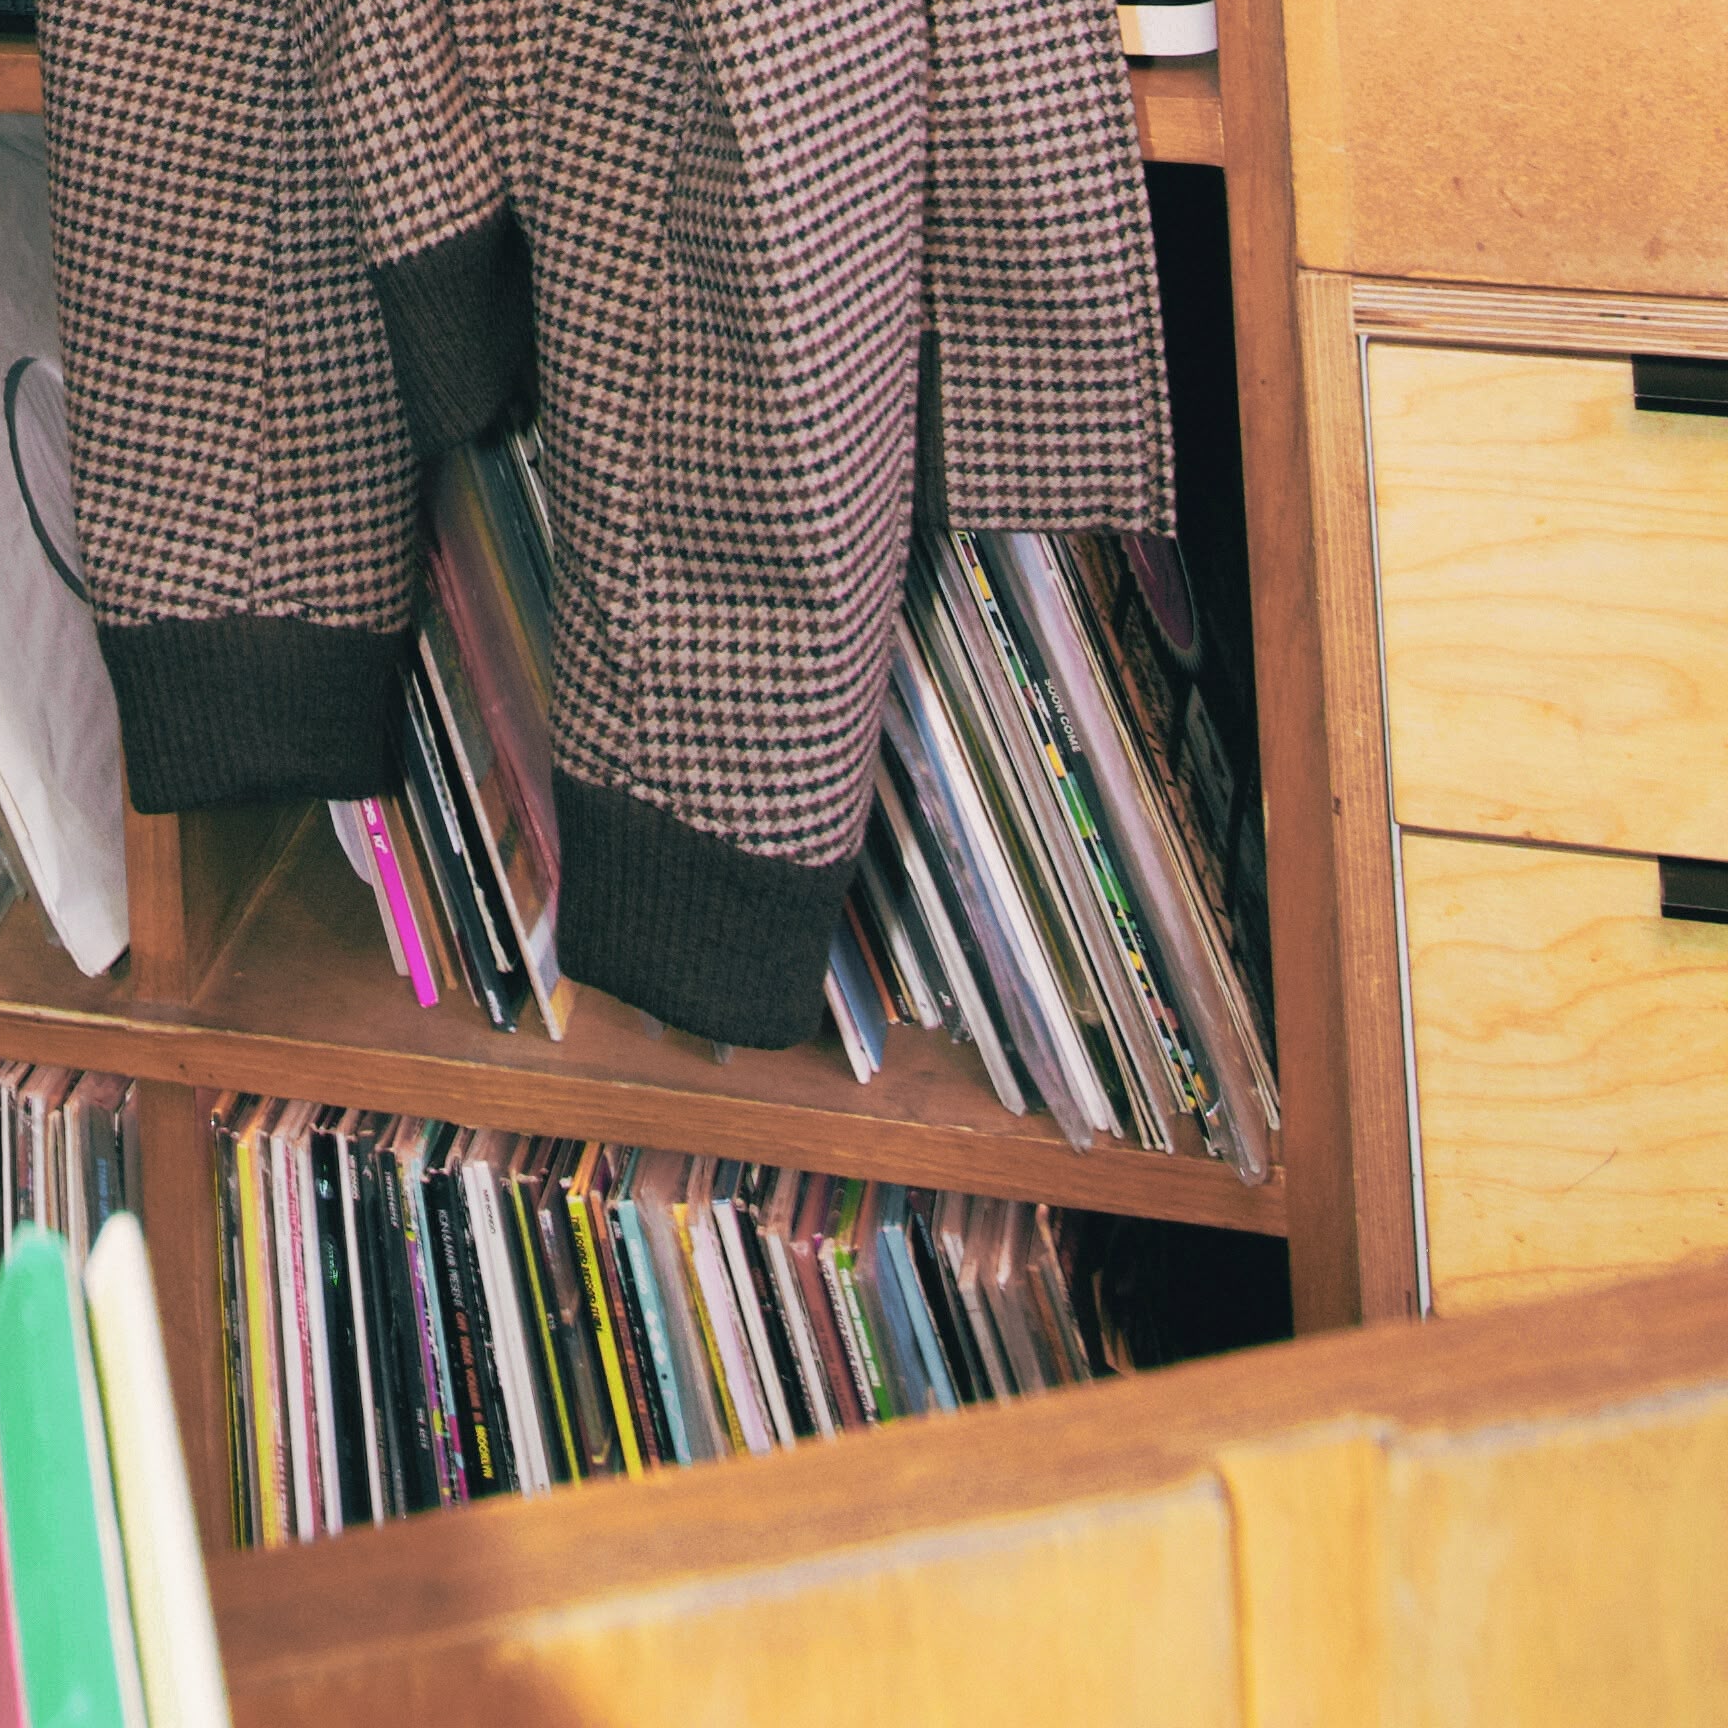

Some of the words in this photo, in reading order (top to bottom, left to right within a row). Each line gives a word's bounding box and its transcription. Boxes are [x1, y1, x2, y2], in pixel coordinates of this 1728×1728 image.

[1044, 678, 1064, 714] SOON
[1060, 715, 1081, 753] COME
[483, 1189, 491, 1203] MR
[484, 1203, 496, 1234] BONGO
[475, 1424, 495, 1480] BROOKLYN
